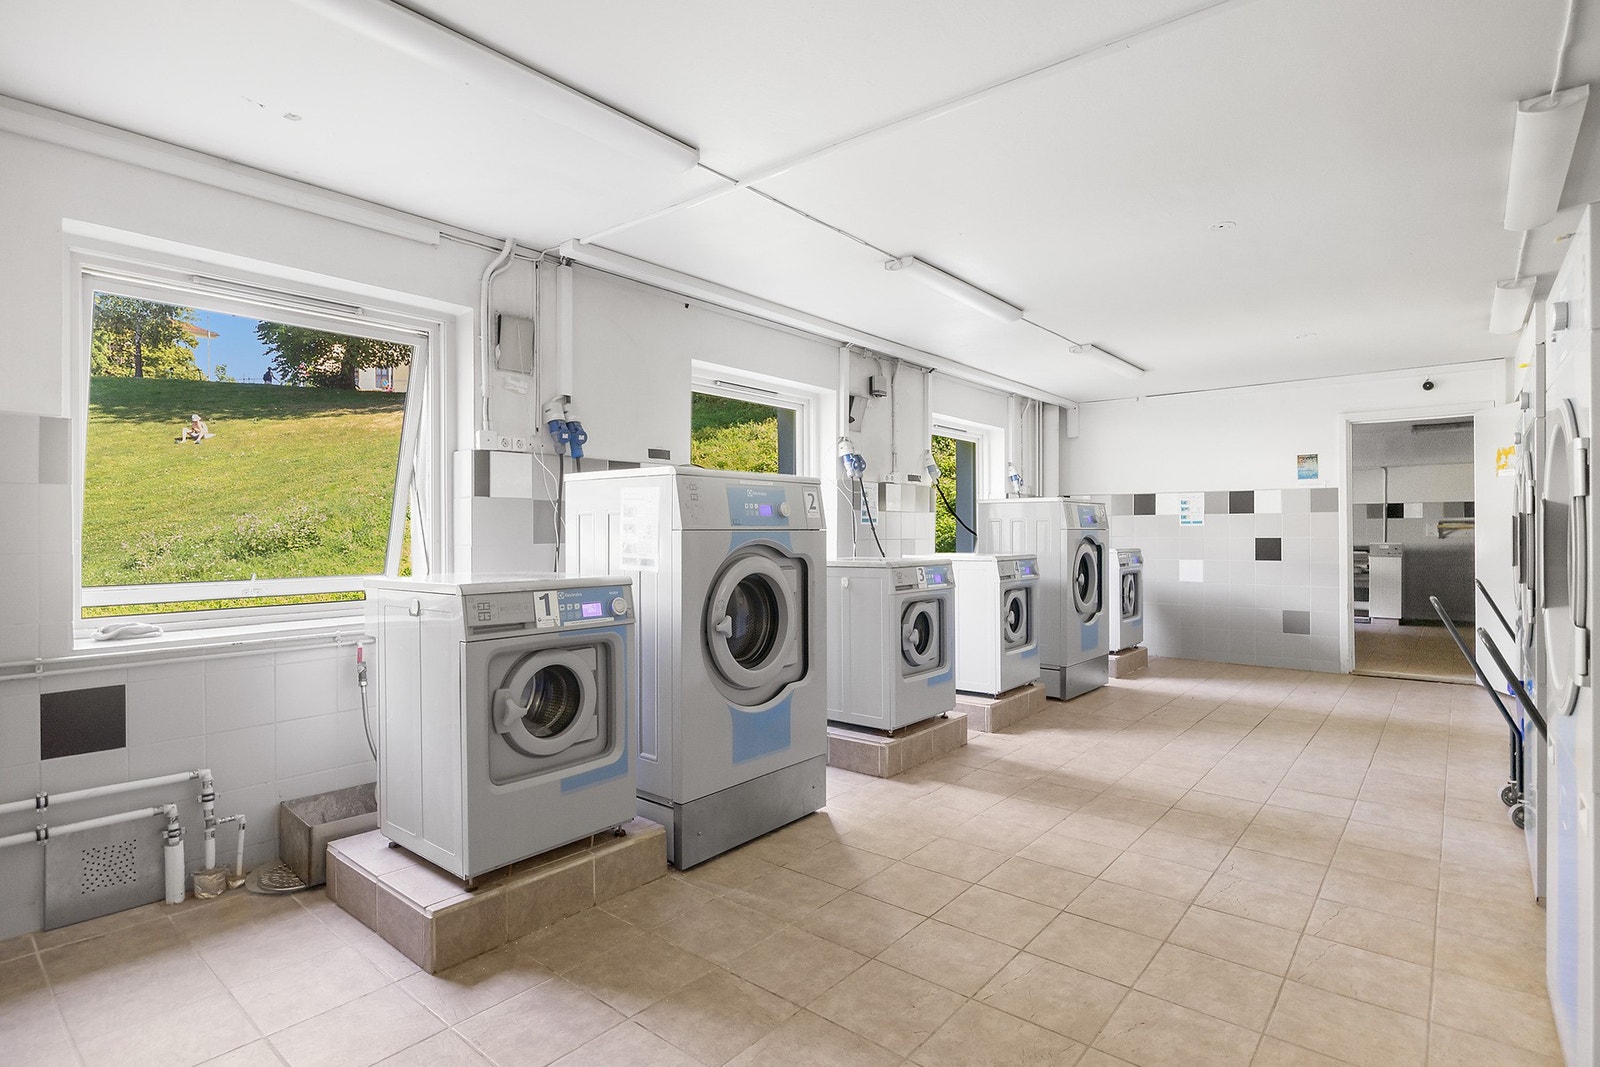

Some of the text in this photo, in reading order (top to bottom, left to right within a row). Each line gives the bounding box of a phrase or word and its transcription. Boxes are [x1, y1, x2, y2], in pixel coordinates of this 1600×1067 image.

[807, 492, 817, 510] 2
[917, 567, 925, 582] 3
[1014, 560, 1020, 573] 4
[538, 592, 551, 616] 1
